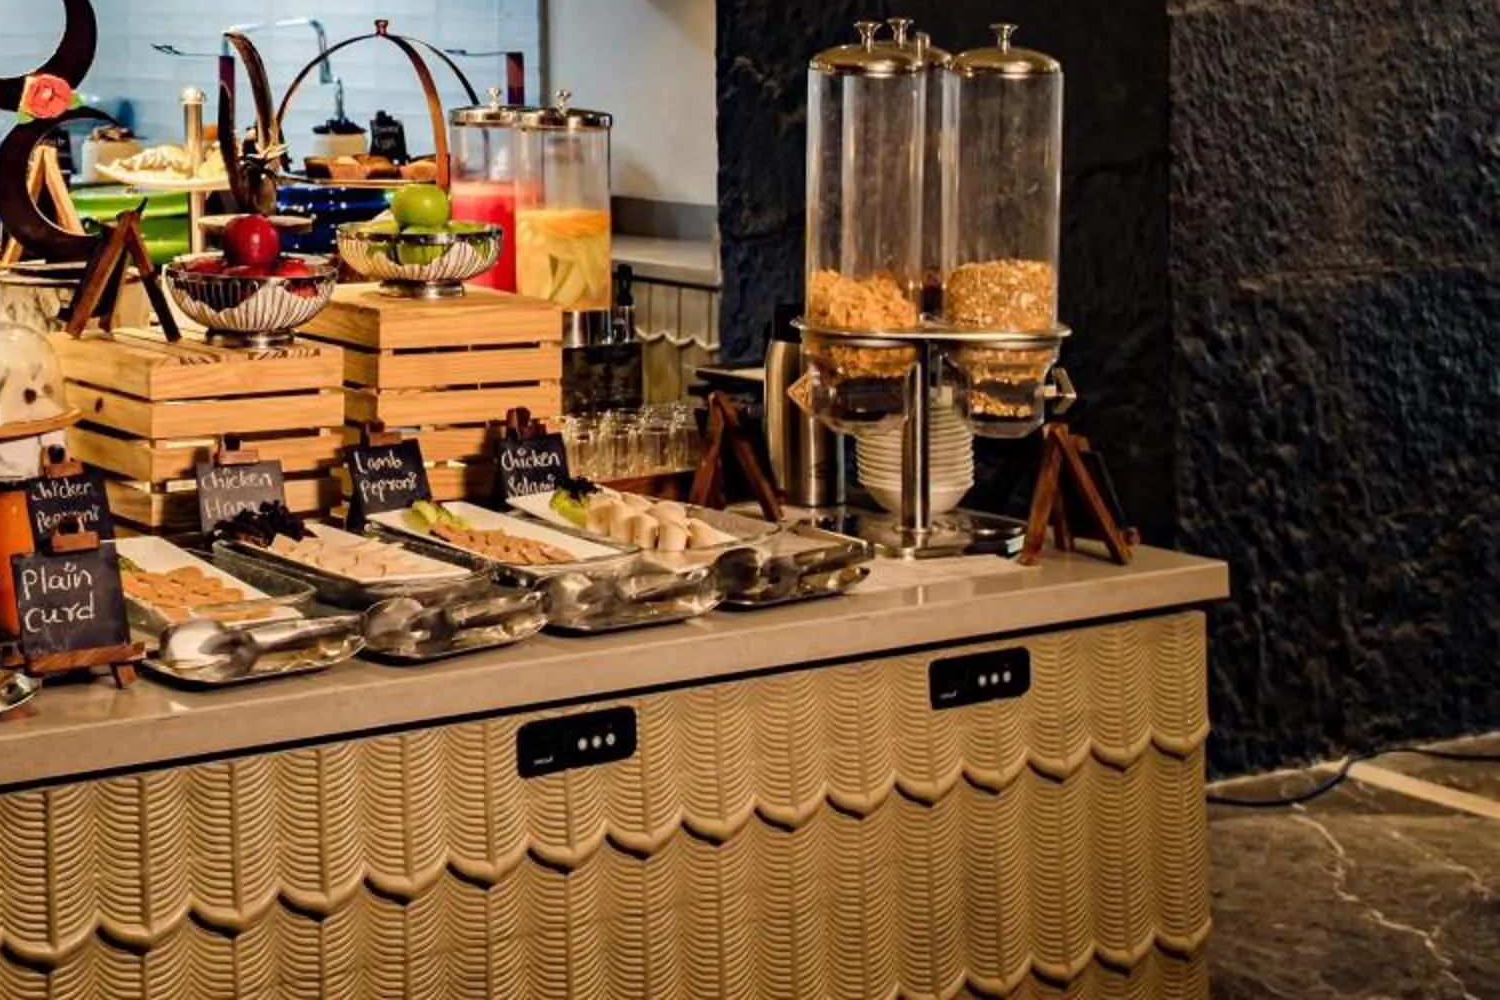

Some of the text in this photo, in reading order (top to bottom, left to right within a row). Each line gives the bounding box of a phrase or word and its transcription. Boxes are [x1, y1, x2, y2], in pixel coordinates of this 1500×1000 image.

[354, 449, 403, 475] Lamb
[501, 447, 560, 471] Chicken
[200, 467, 273, 490] Chicken
[22, 561, 93, 601] Plain
